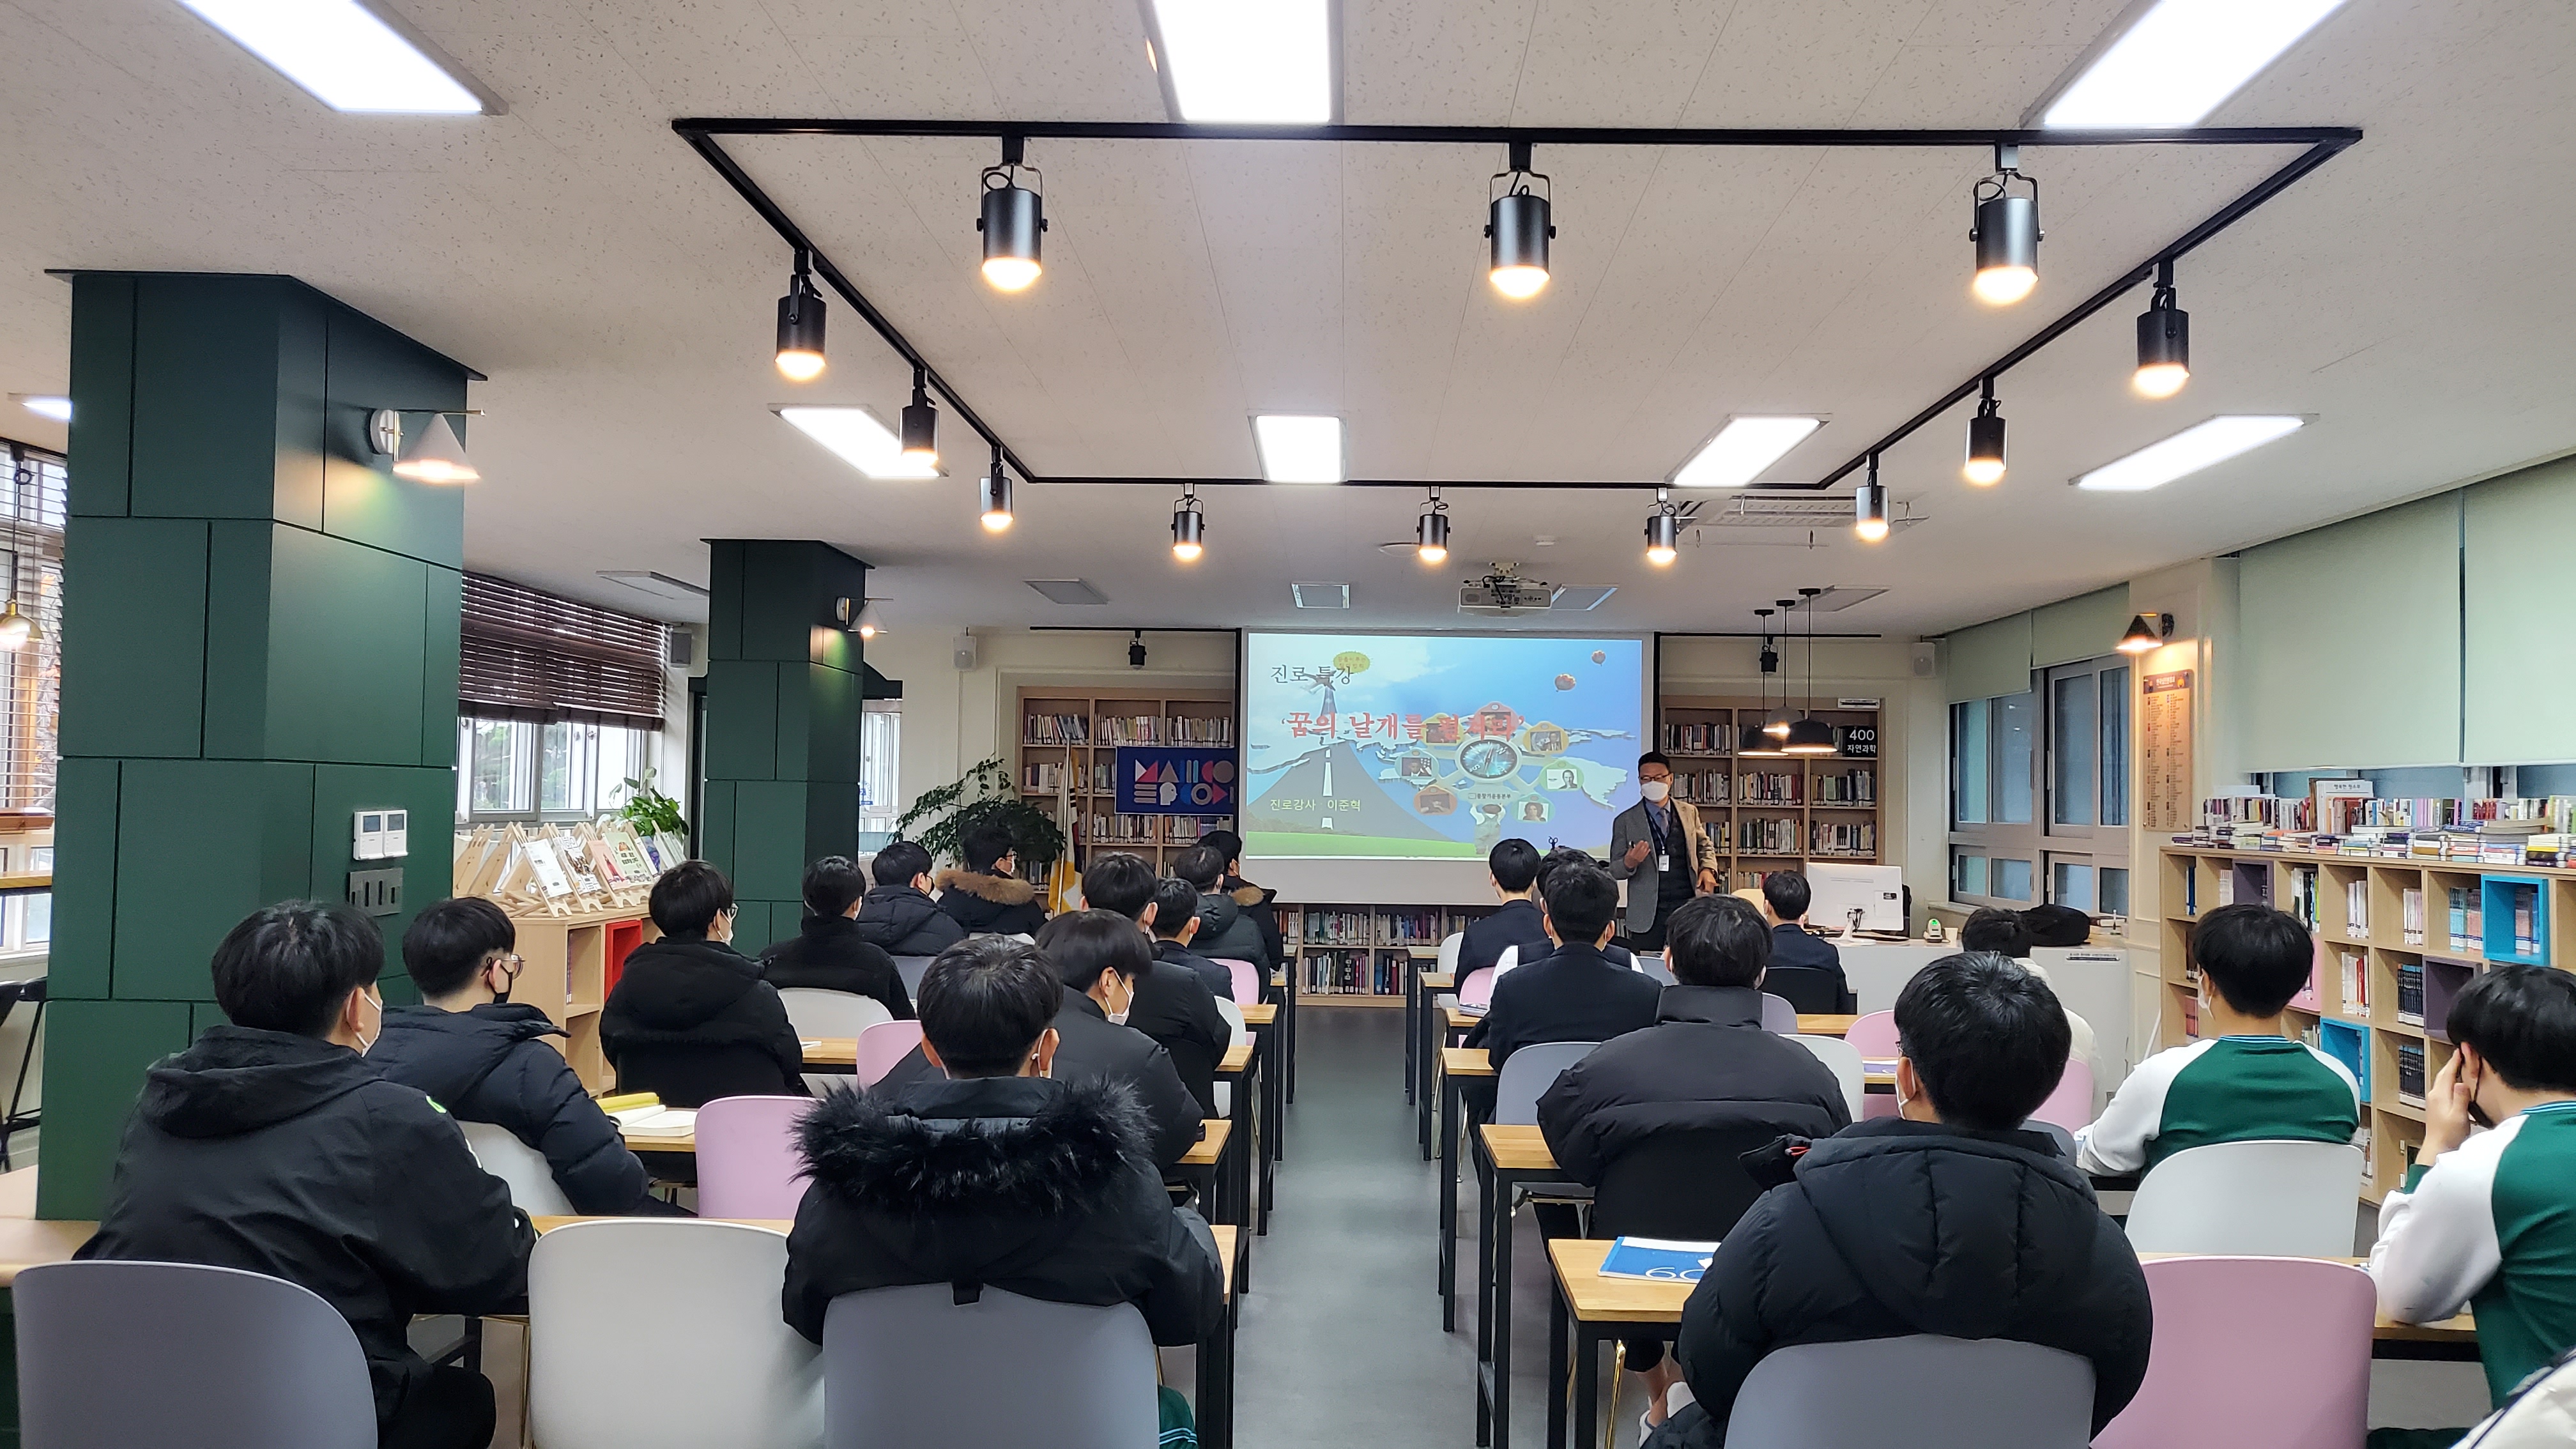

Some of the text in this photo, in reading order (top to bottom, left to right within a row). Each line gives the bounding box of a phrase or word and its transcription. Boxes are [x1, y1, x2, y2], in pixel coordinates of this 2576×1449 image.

[1270, 664, 1354, 685] 진로 특강
[1282, 712, 1336, 739] ‘꿈의
[1349, 712, 1428, 740] 날개를
[1849, 729, 1874, 741] 400
[1847, 744, 1876, 753] 자연과학
[1270, 799, 1316, 811] 진로강사
[1327, 799, 1361, 812] 이준혁
